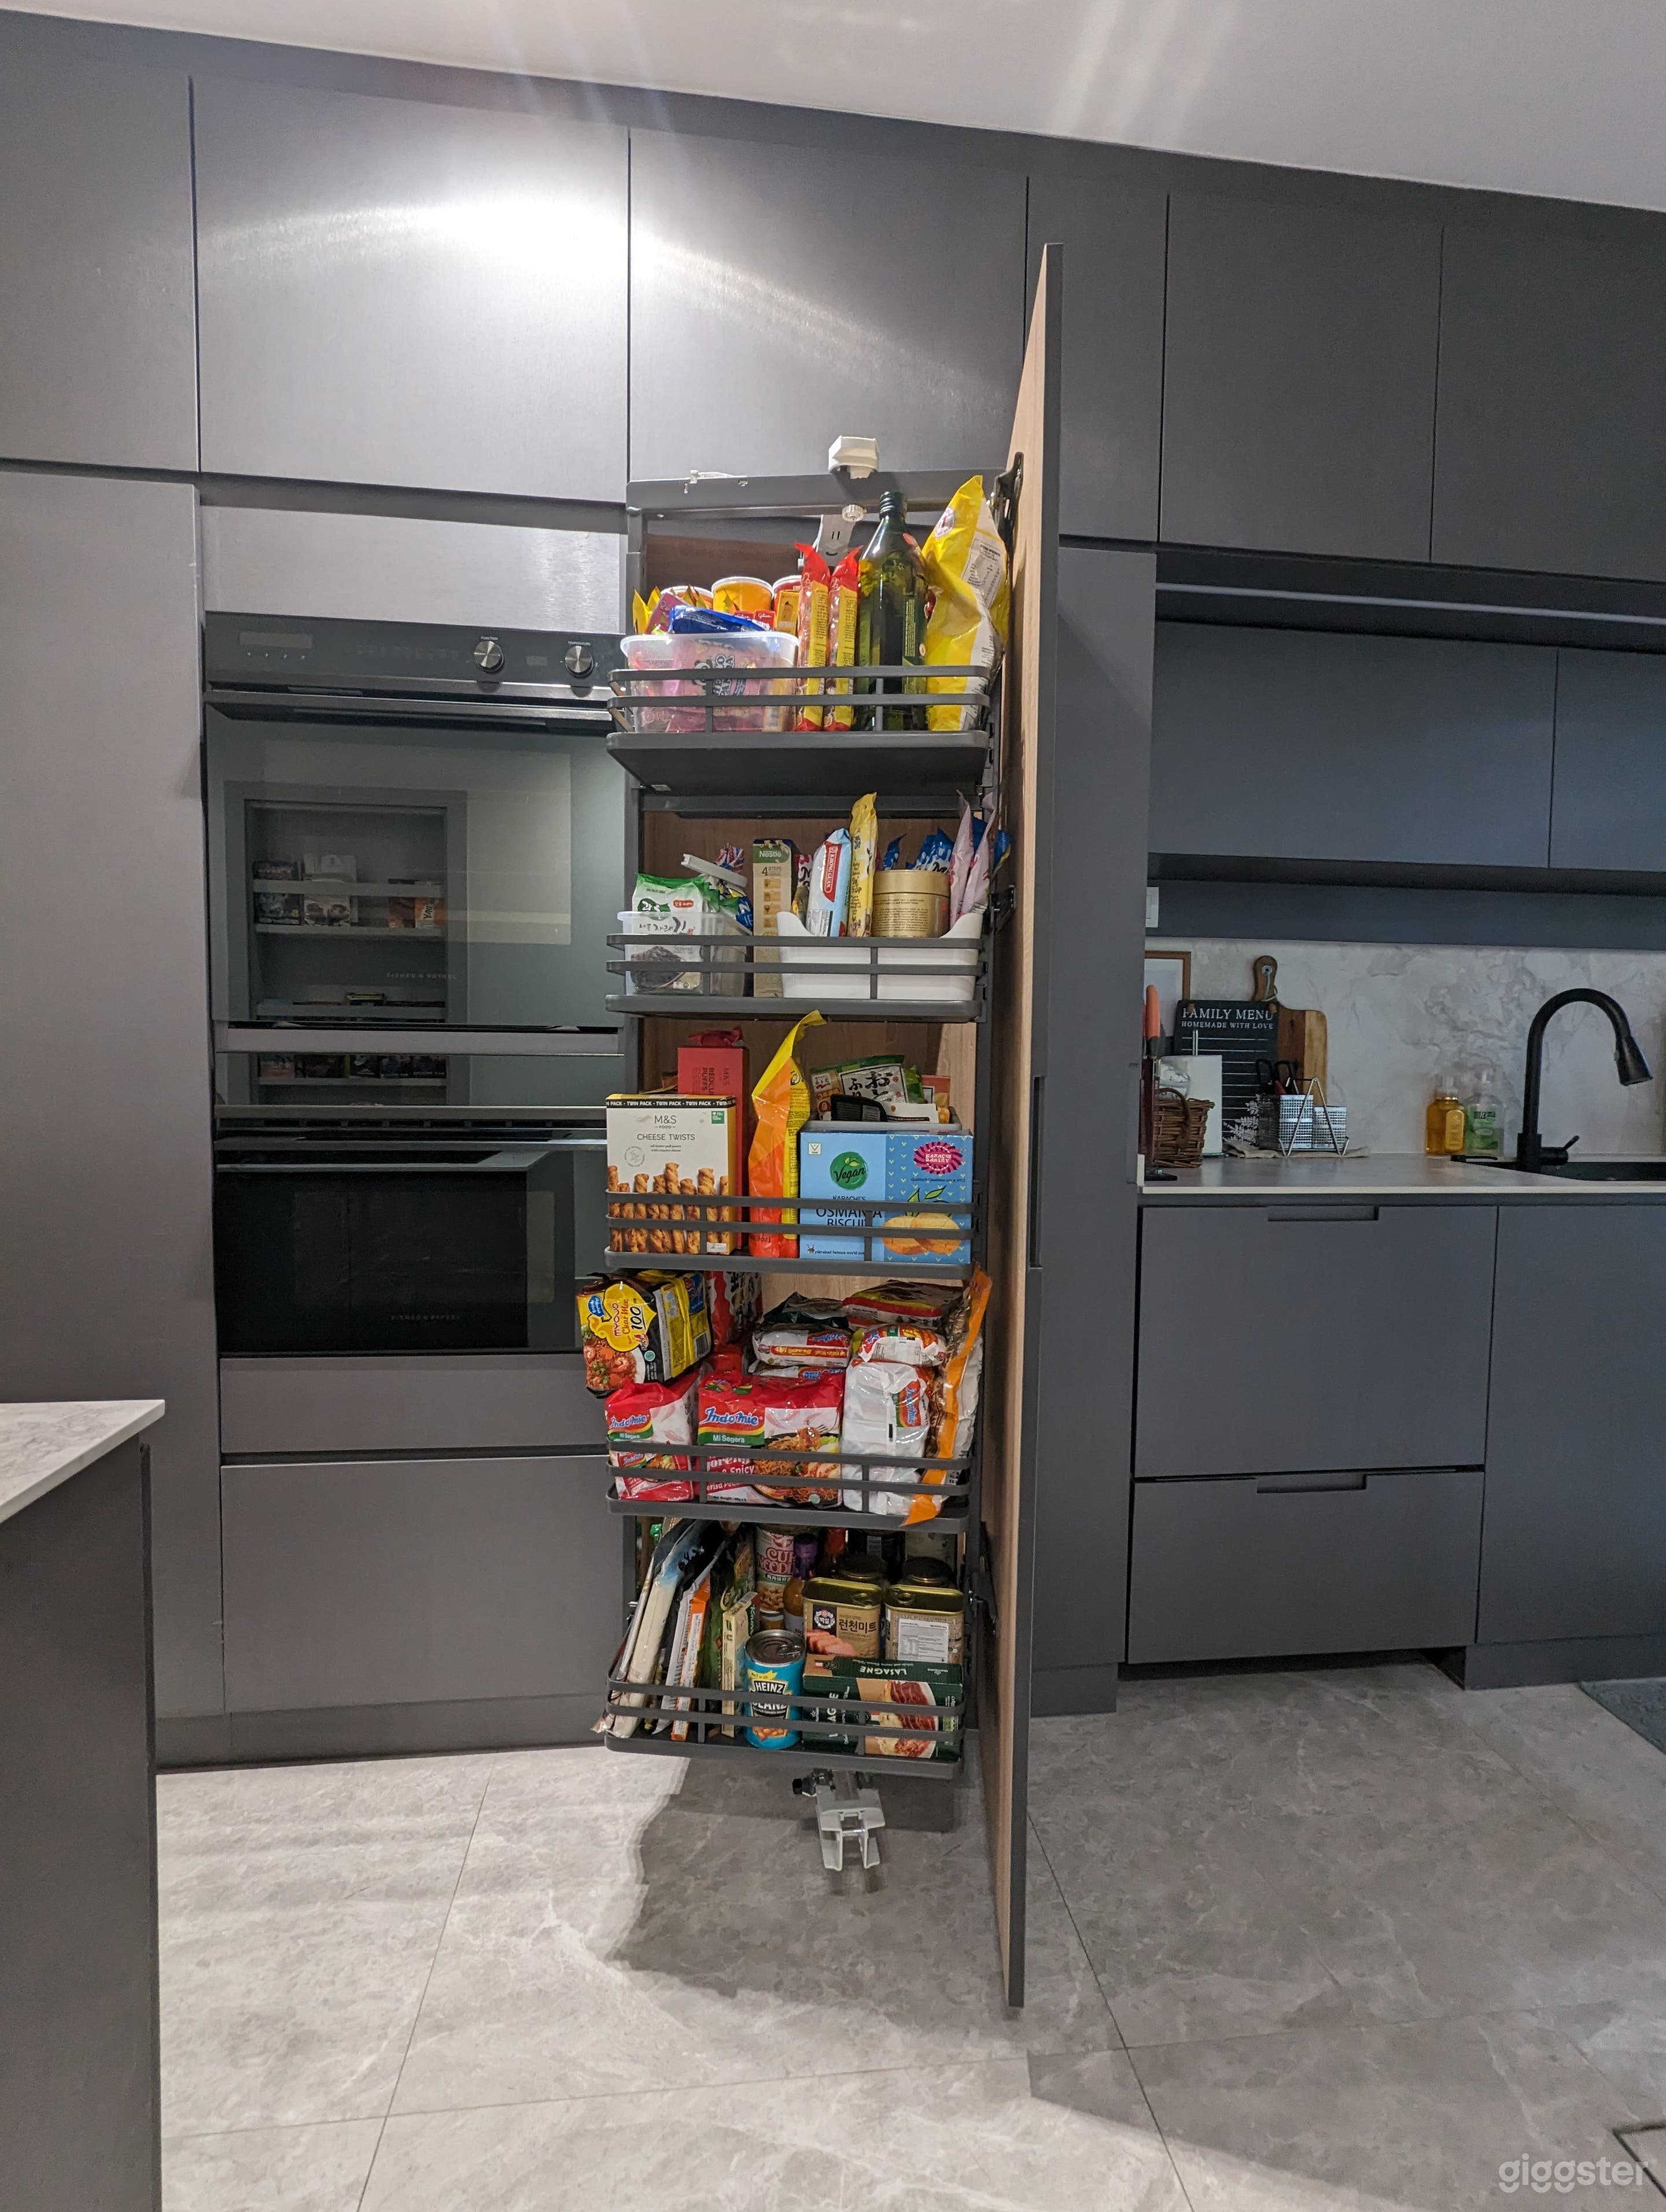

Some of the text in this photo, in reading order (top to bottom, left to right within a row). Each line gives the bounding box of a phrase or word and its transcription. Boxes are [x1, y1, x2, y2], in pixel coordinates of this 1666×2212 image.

[762, 867, 768, 876] 4
[1182, 1008, 1273, 1021] FAMILY MENU
[654, 1115, 677, 1124] M&S
[834, 1166, 865, 1183] Vegan
[816, 1208, 882, 1218] OSMANA
[629, 1306, 643, 1330] 100
[609, 1415, 647, 1428] Indomie
[699, 1406, 759, 1426] Indomie
[723, 1435, 745, 1443] Segera
[838, 1618, 878, 1633] 런천미트
[860, 1666, 908, 1675] LASAGNE
[755, 1682, 783, 1693] HEINZ
